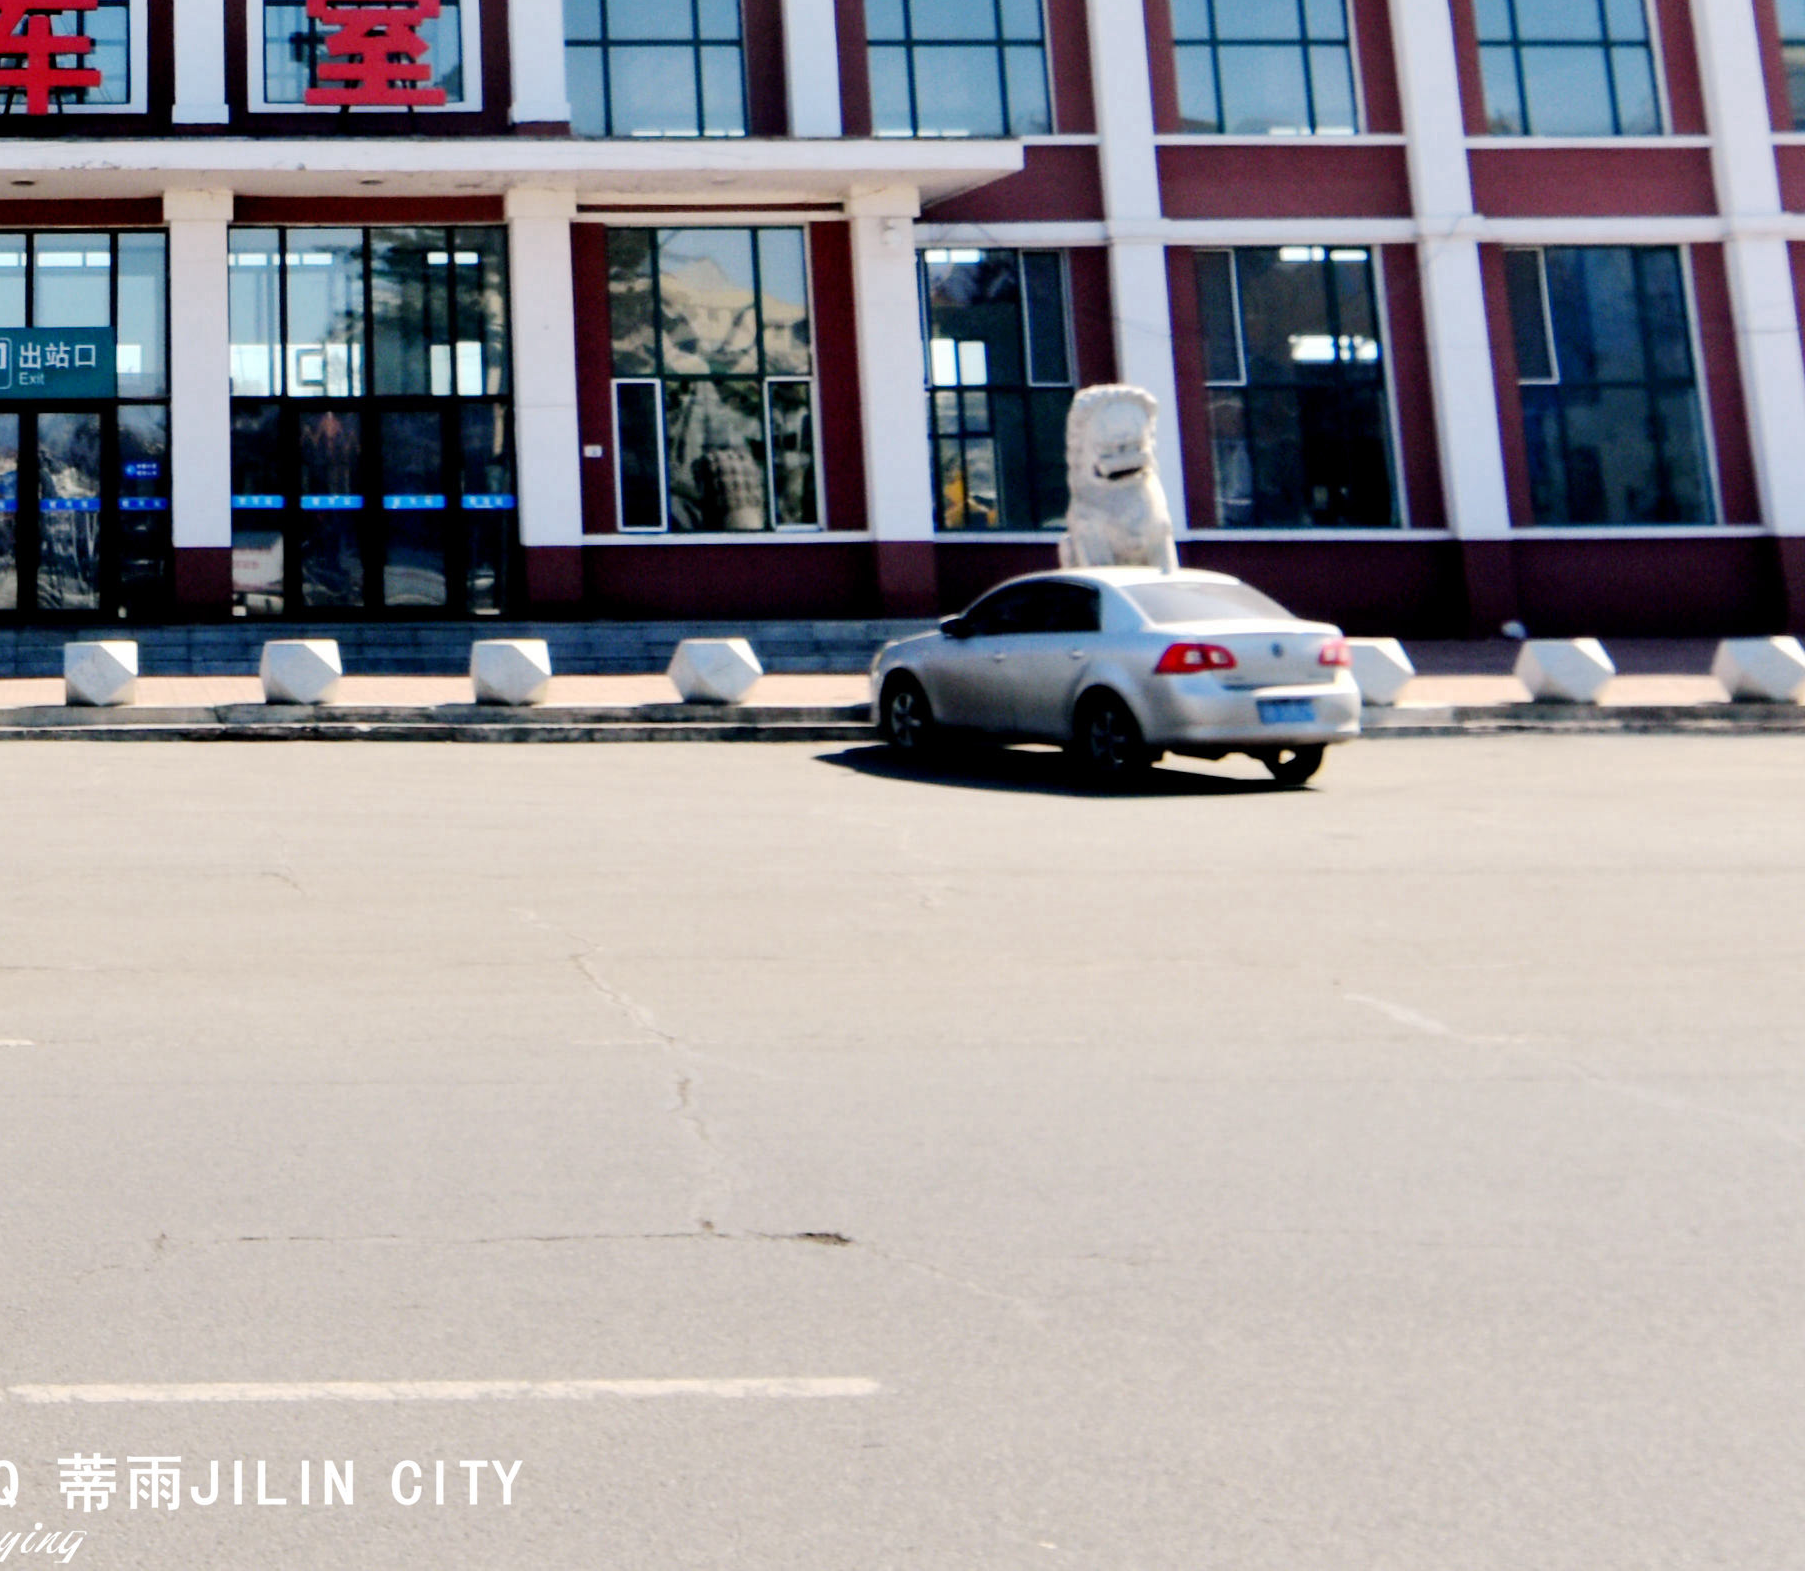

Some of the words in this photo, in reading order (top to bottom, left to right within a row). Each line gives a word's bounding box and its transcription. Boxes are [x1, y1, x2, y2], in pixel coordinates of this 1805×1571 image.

[18, 342, 97, 369] 出站口
[18, 372, 45, 386] Exit
